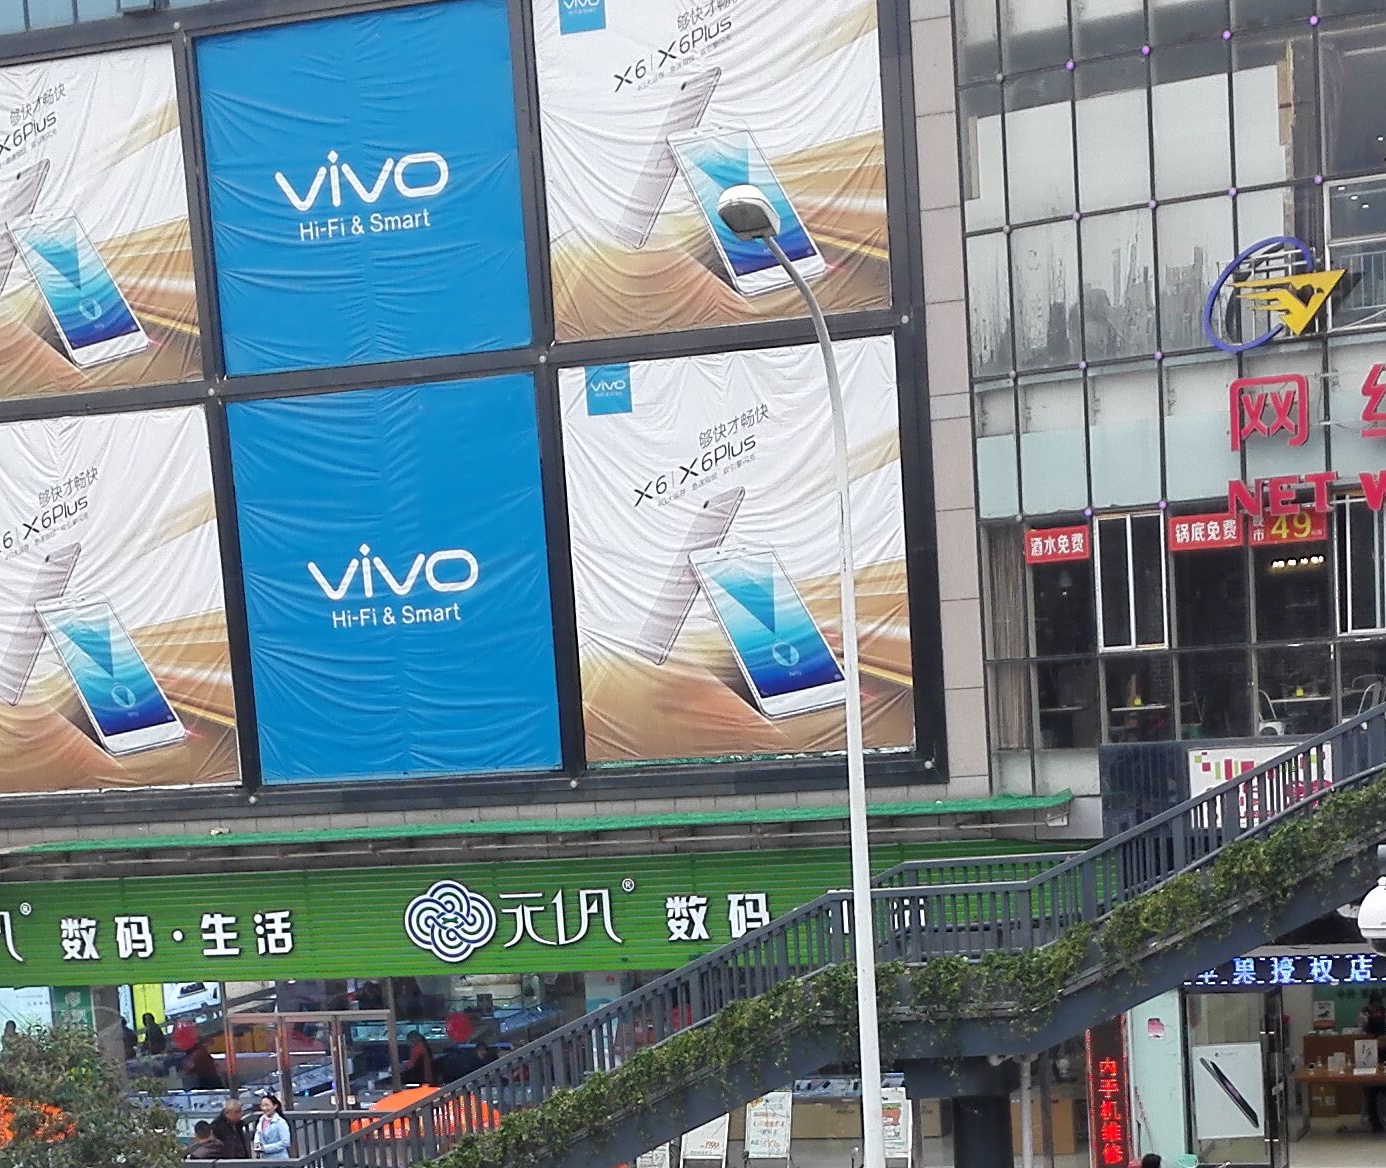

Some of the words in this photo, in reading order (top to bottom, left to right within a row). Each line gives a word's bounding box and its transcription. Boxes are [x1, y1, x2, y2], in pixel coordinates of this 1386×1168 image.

[677, 0, 739, 31] 够快才畅
[275, 150, 449, 212] vivo
[299, 217, 345, 241] Hi-Fi
[351, 215, 365, 236] &
[370, 208, 431, 234] Smart
[590, 379, 626, 392] vivo
[699, 403, 770, 449] 够快才畅快
[38, 466, 99, 508] 够快才畅快
[1227, 471, 1339, 519] NET
[1175, 518, 1238, 542] 锅底免费
[307, 543, 479, 600] vivo
[332, 607, 377, 628] Hi-Fi
[382, 606, 396, 625] &
[401, 602, 462, 625] Smart
